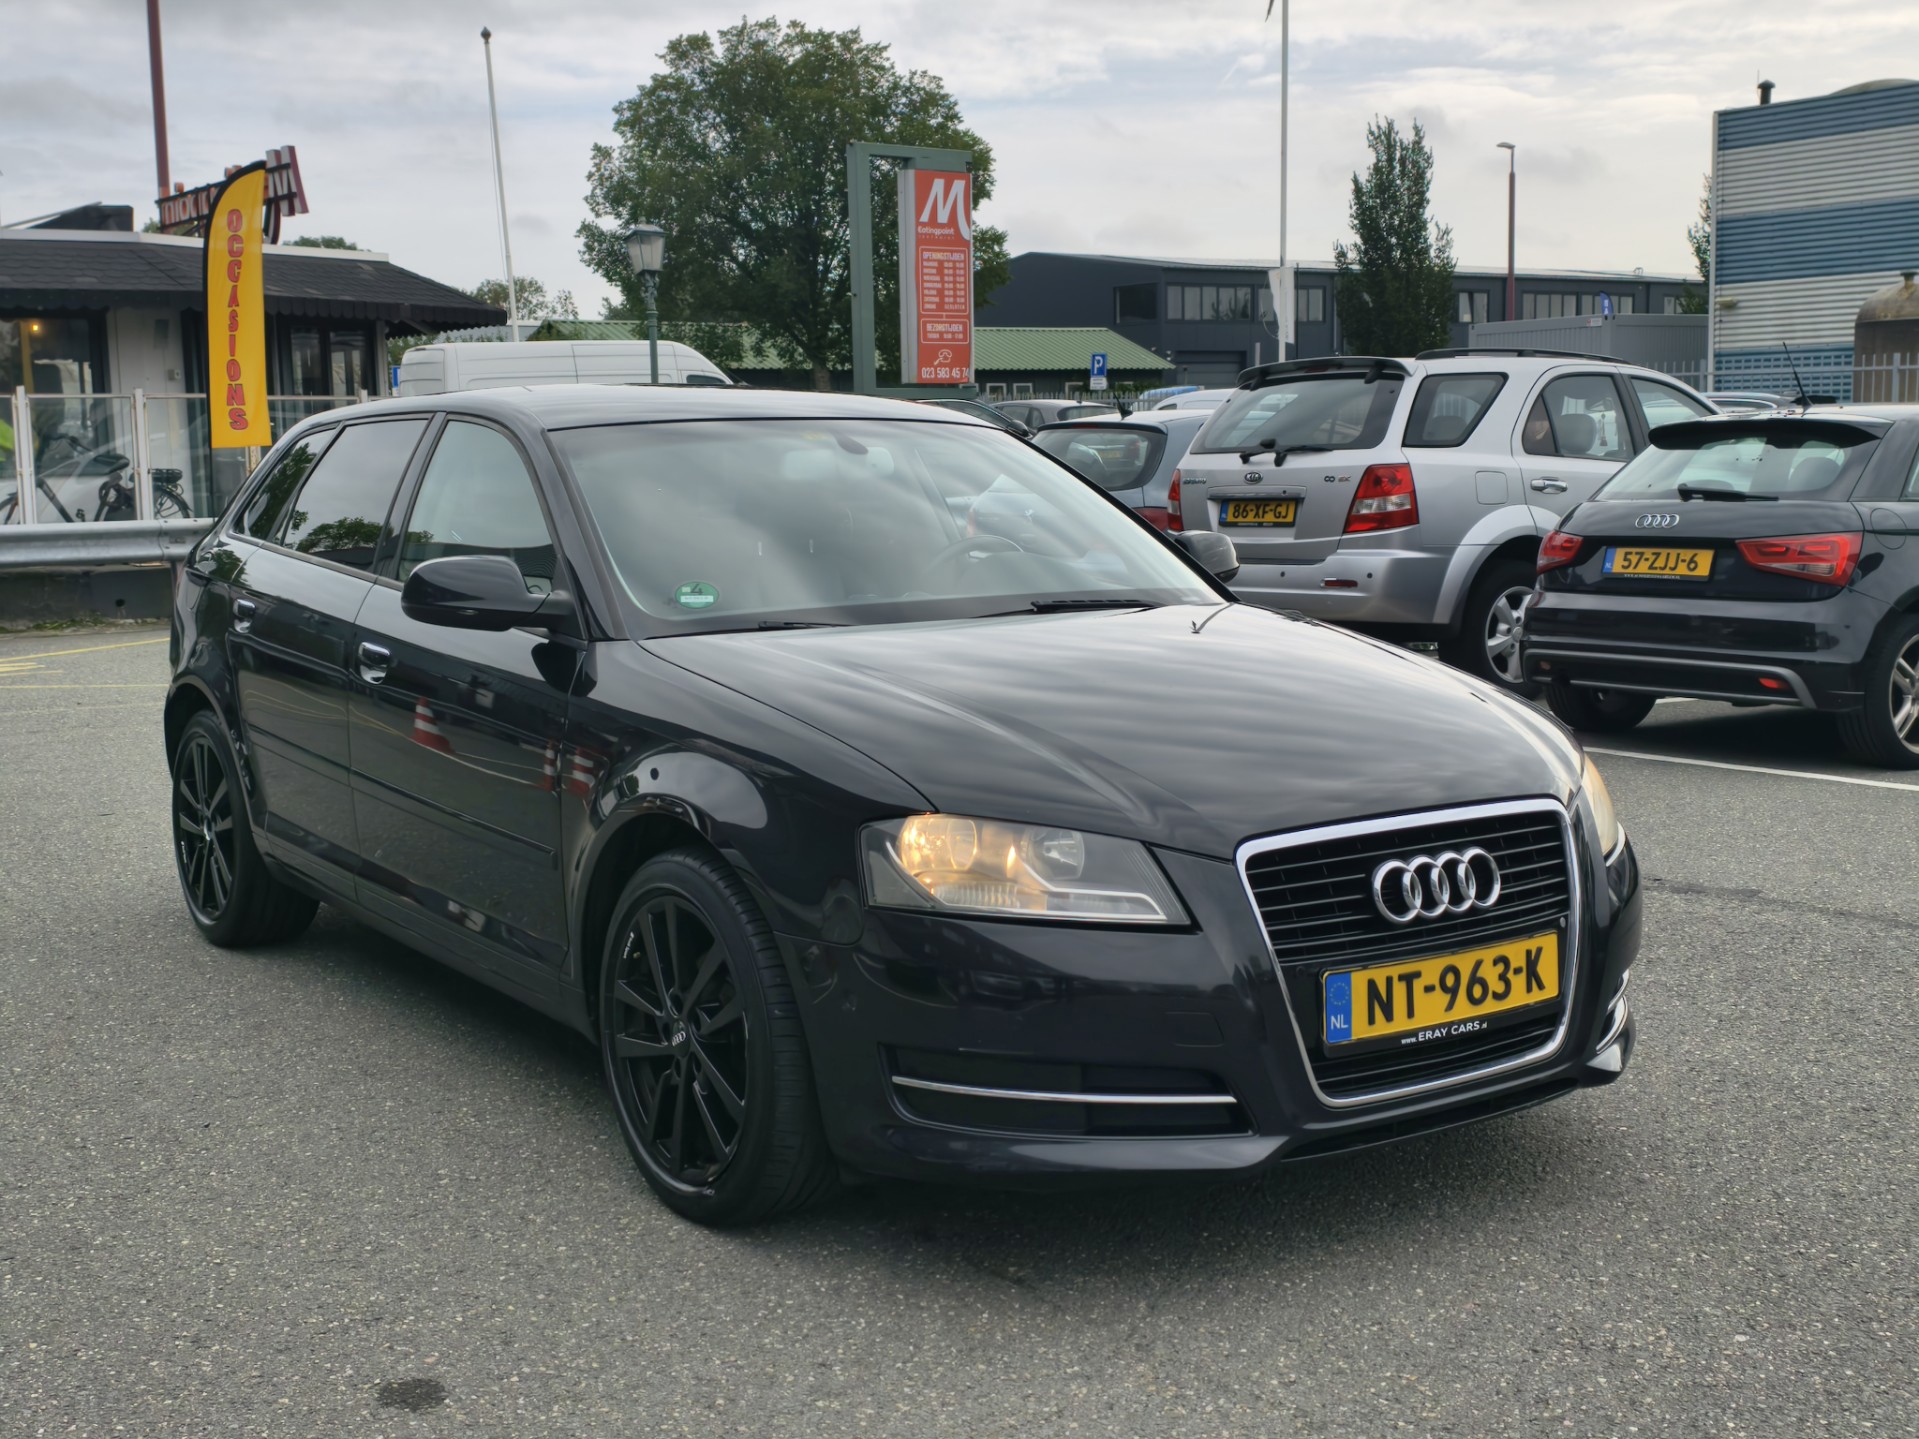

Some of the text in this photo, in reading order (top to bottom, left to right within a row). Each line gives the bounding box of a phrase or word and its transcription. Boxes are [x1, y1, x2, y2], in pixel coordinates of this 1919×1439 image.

[226, 208, 249, 431] OCCASIONS
[921, 367, 935, 378] 023
[936, 367, 950, 378] 583
[951, 367, 961, 378] 45
[1093, 356, 1103, 374] P
[1232, 502, 1290, 520] 86-XF-GJ
[1621, 551, 1699, 573] 57-ZJJ-6
[1367, 946, 1546, 1027] NT-963-K
[1330, 1014, 1349, 1031] NL
